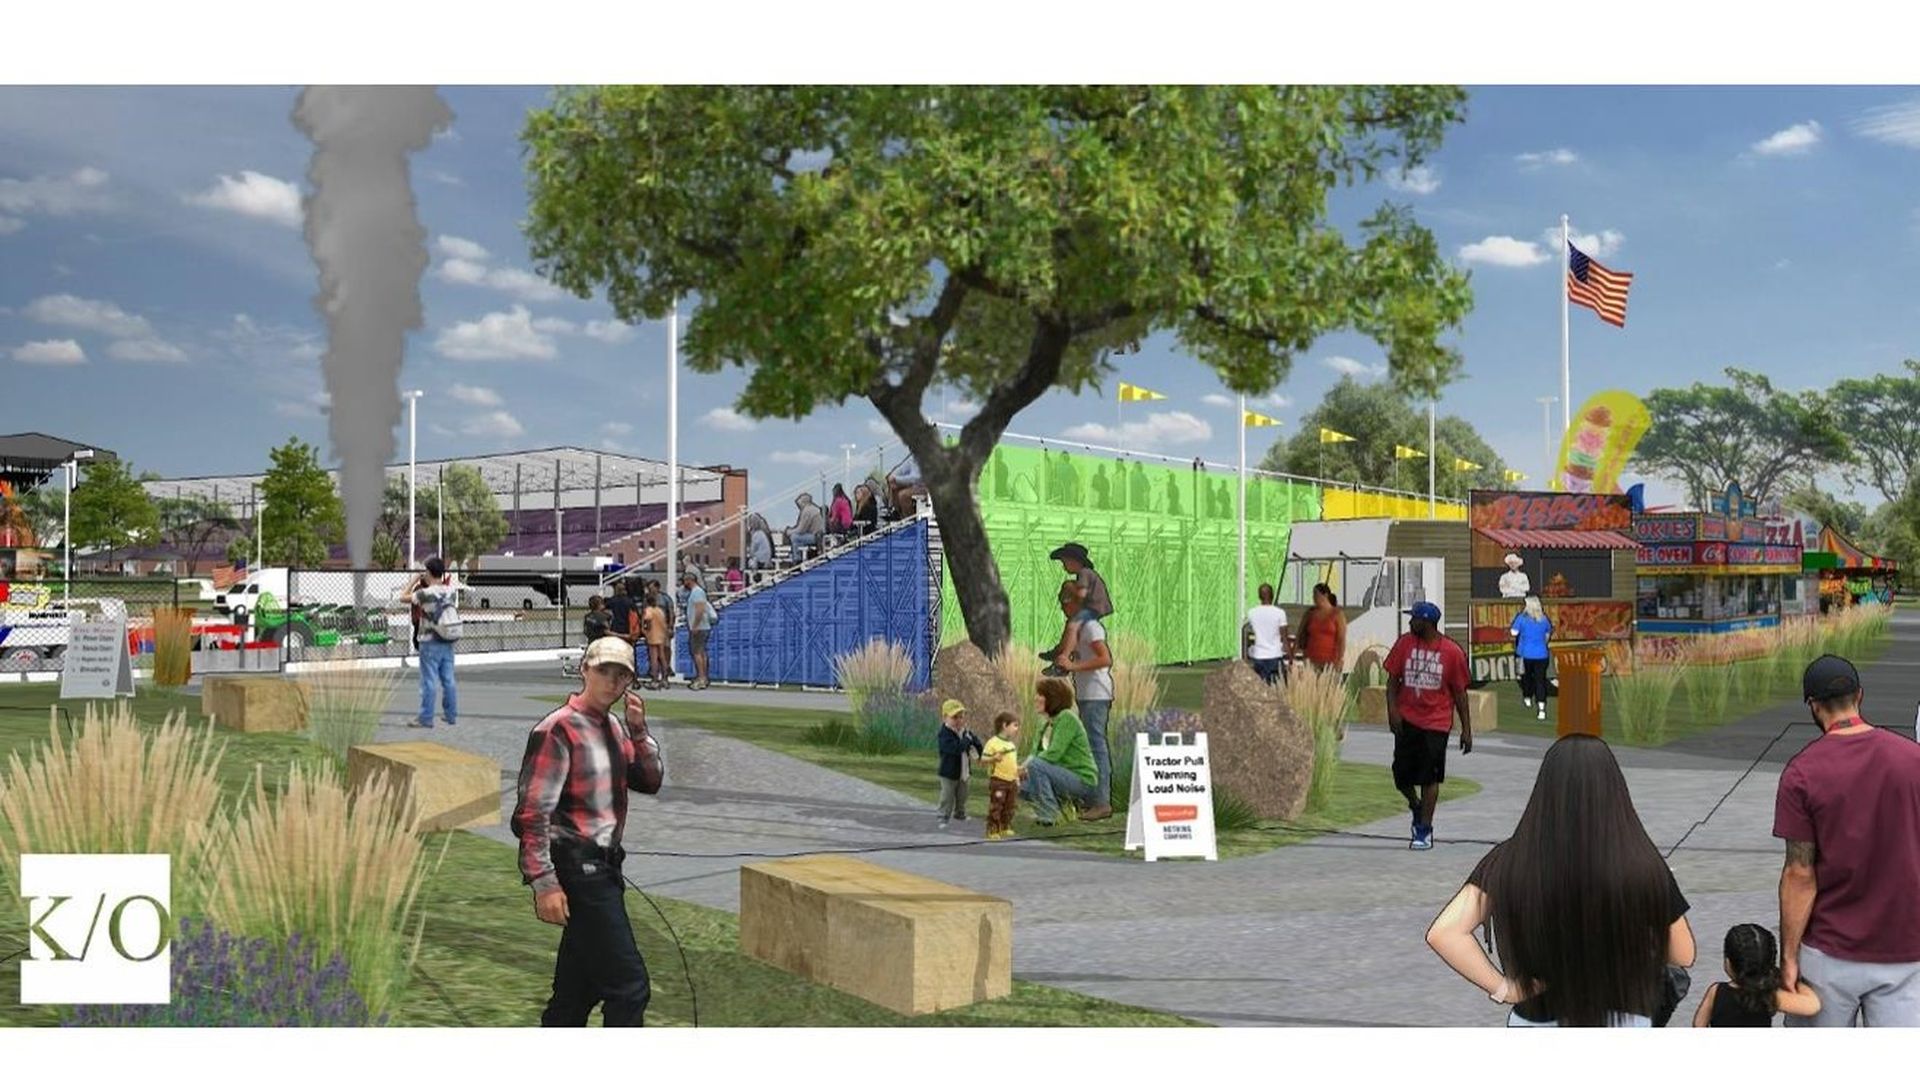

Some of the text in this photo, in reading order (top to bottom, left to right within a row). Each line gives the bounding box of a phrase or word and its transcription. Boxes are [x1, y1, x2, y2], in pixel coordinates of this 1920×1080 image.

[1656, 546, 1692, 563] OVEN
[1144, 756, 1204, 767] Tractor Pull
[1153, 770, 1197, 782] Warning
[1147, 784, 1206, 794] Loud Noise
